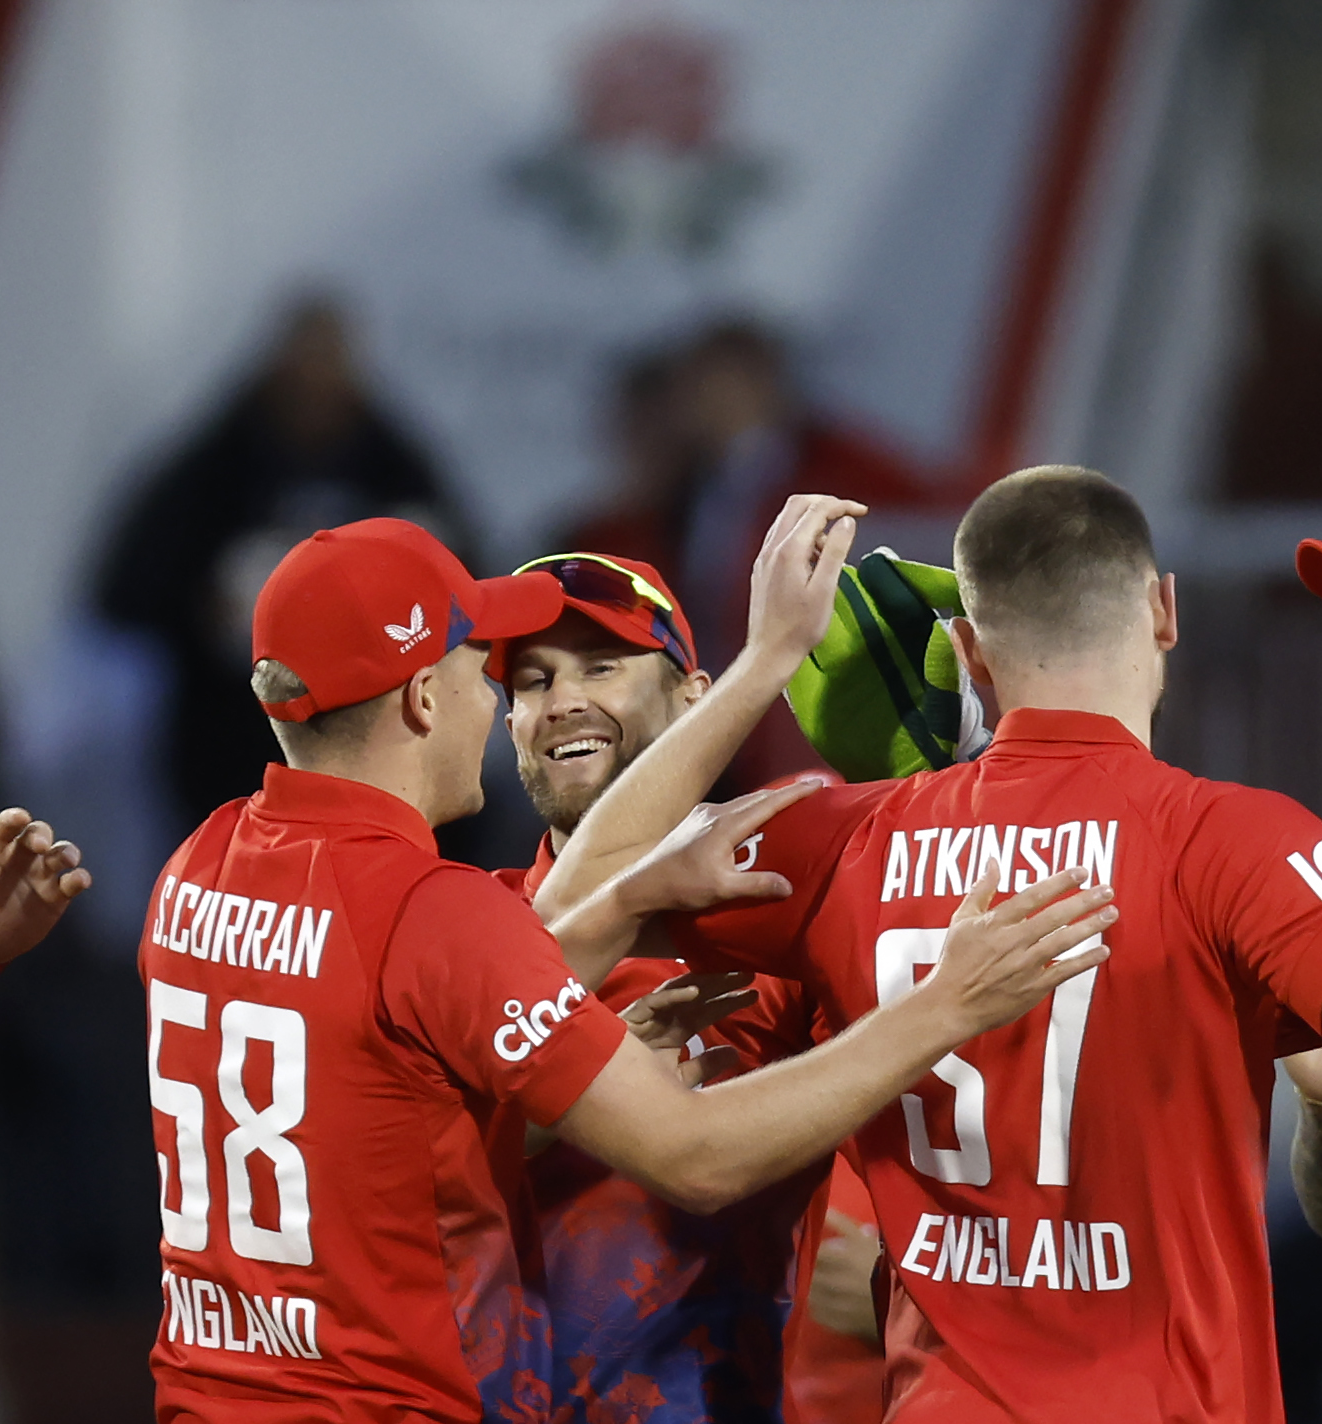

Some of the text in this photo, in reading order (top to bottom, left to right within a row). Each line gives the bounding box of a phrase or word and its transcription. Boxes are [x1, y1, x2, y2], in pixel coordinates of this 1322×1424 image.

[880, 820, 1118, 902] ATKINSON
[152, 874, 333, 979] S.CURRAN
[148, 977, 313, 1267] 58
[900, 1212, 1131, 1291] ENGLAND
[162, 1269, 323, 1360] NGLAND
